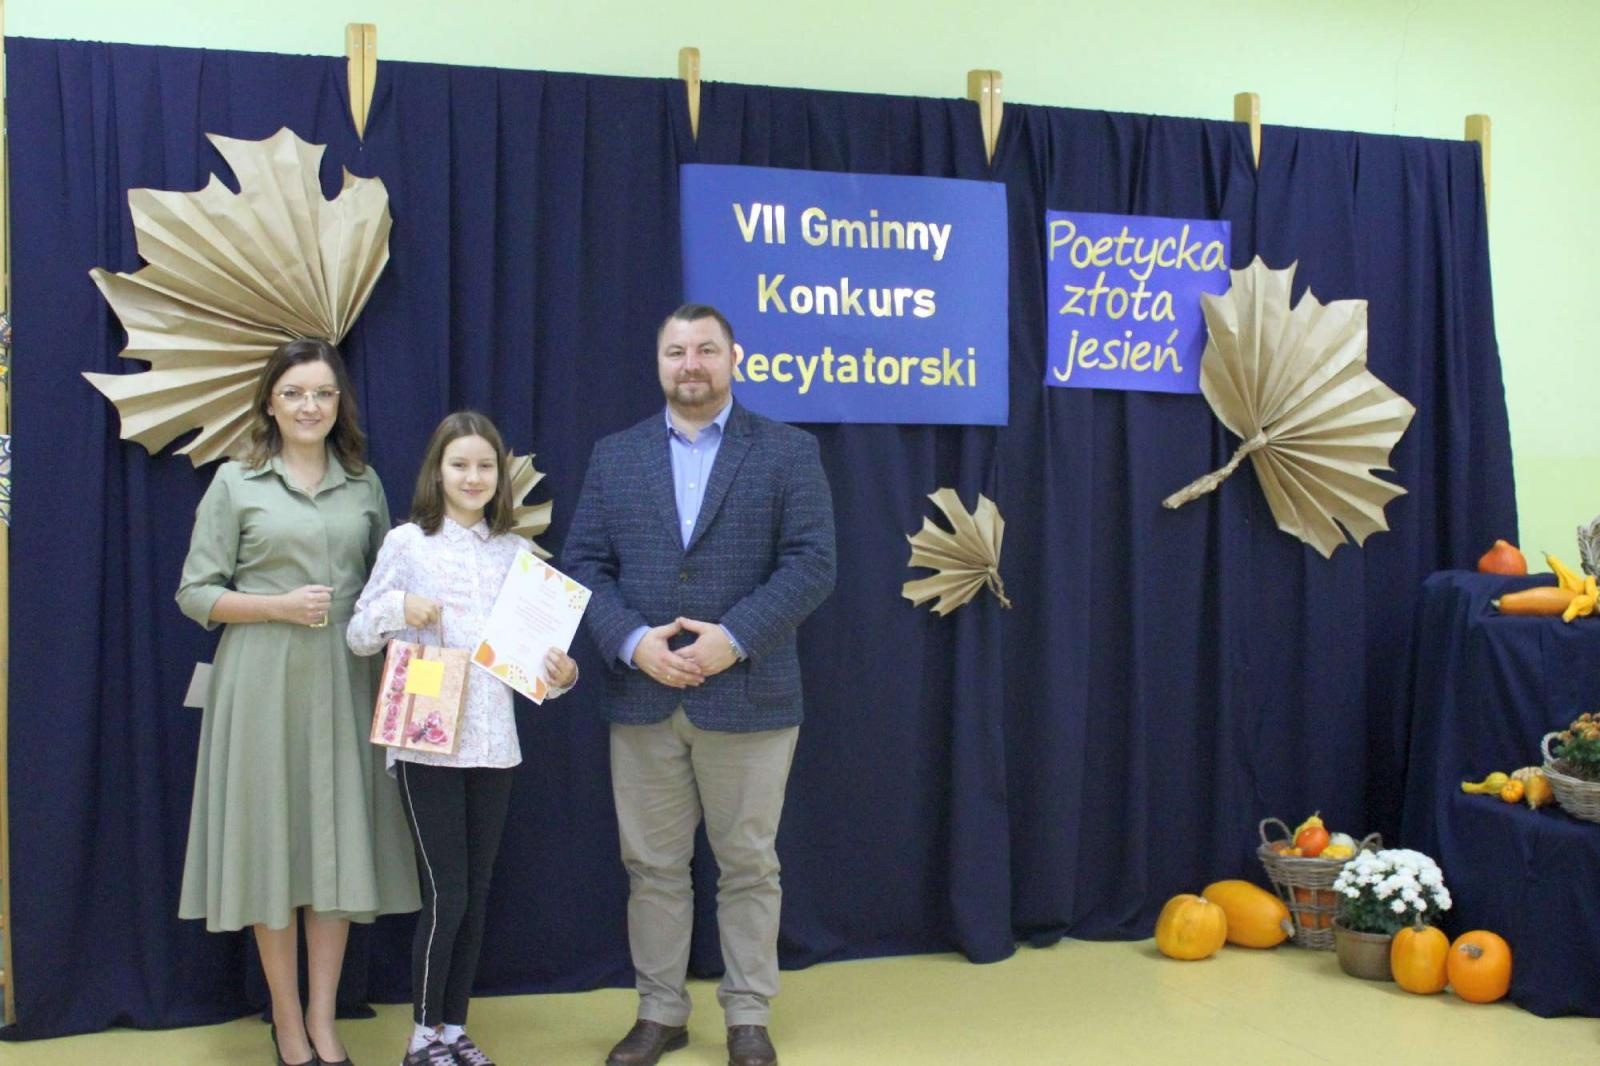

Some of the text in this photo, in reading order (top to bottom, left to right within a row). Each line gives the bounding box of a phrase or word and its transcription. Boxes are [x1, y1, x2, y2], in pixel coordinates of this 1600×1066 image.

[732, 203, 952, 261] VII Gminny
[1049, 219, 1228, 281] Poetycka
[757, 274, 936, 318] Konkurs
[1059, 271, 1175, 321] złota
[1053, 328, 1183, 382] jesień
